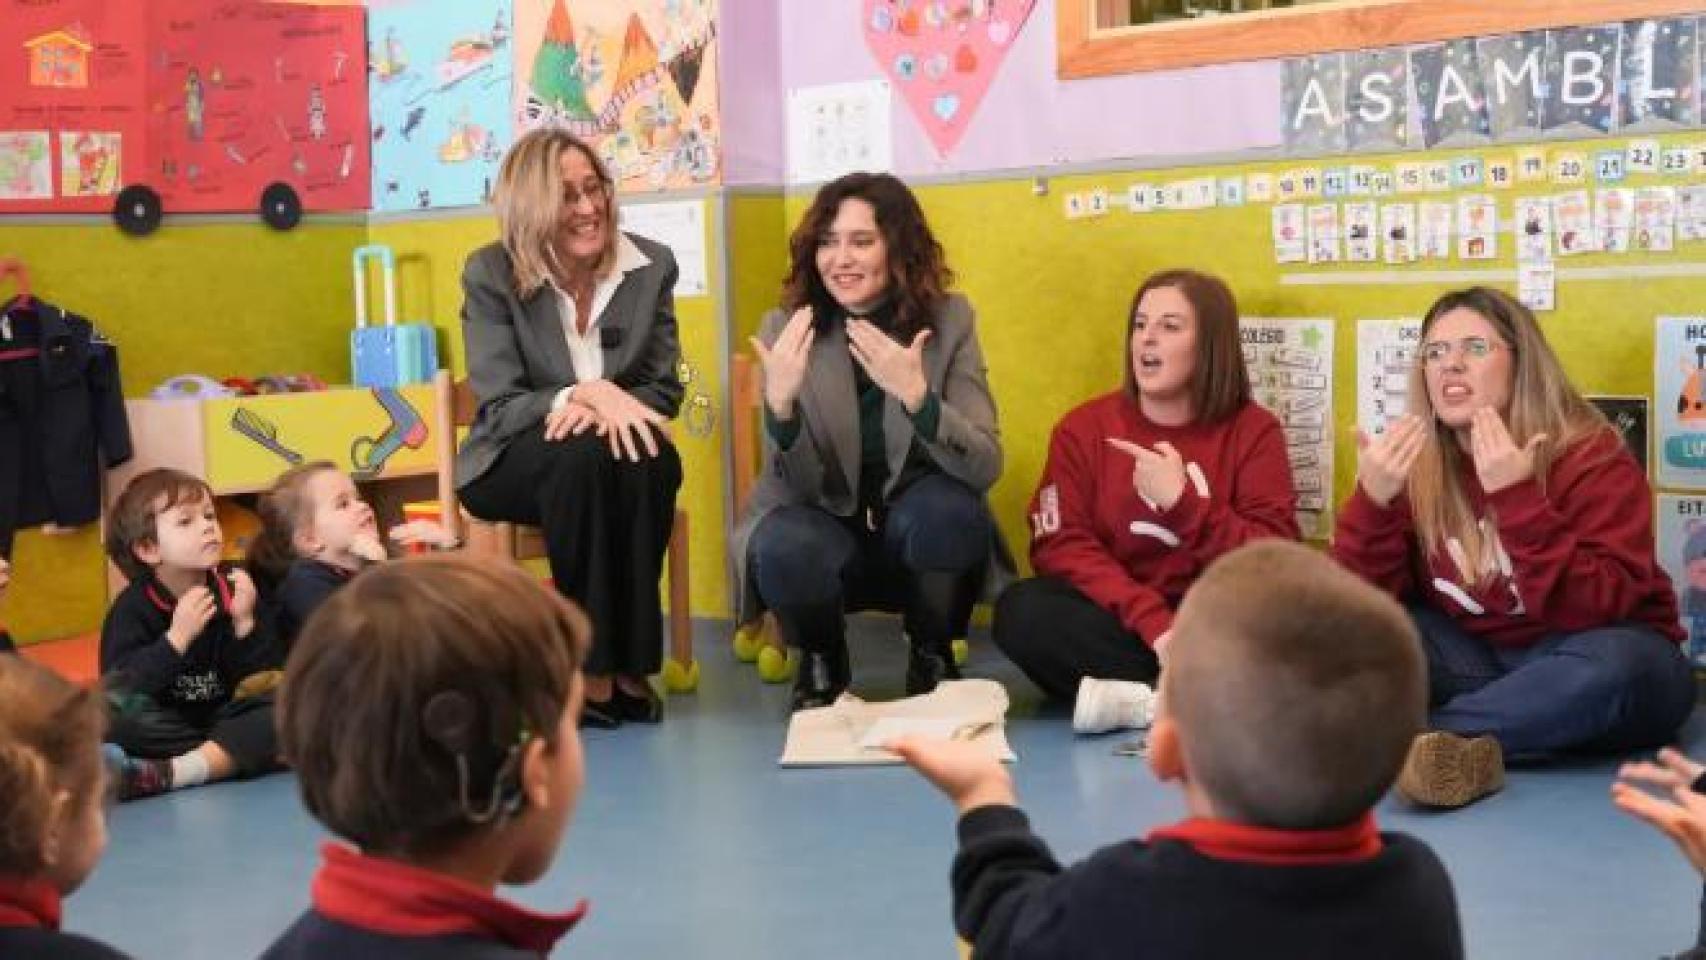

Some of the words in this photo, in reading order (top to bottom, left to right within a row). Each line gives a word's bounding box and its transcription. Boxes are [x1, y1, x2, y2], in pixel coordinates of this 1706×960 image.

[1402, 169, 1418, 184] 15
[1460, 163, 1475, 178] 17
[1491, 166, 1507, 182] 18
[1560, 162, 1580, 177] 20
[1602, 160, 1619, 176] 21
[1633, 149, 1653, 166] 22
[1664, 154, 1687, 169] 23
